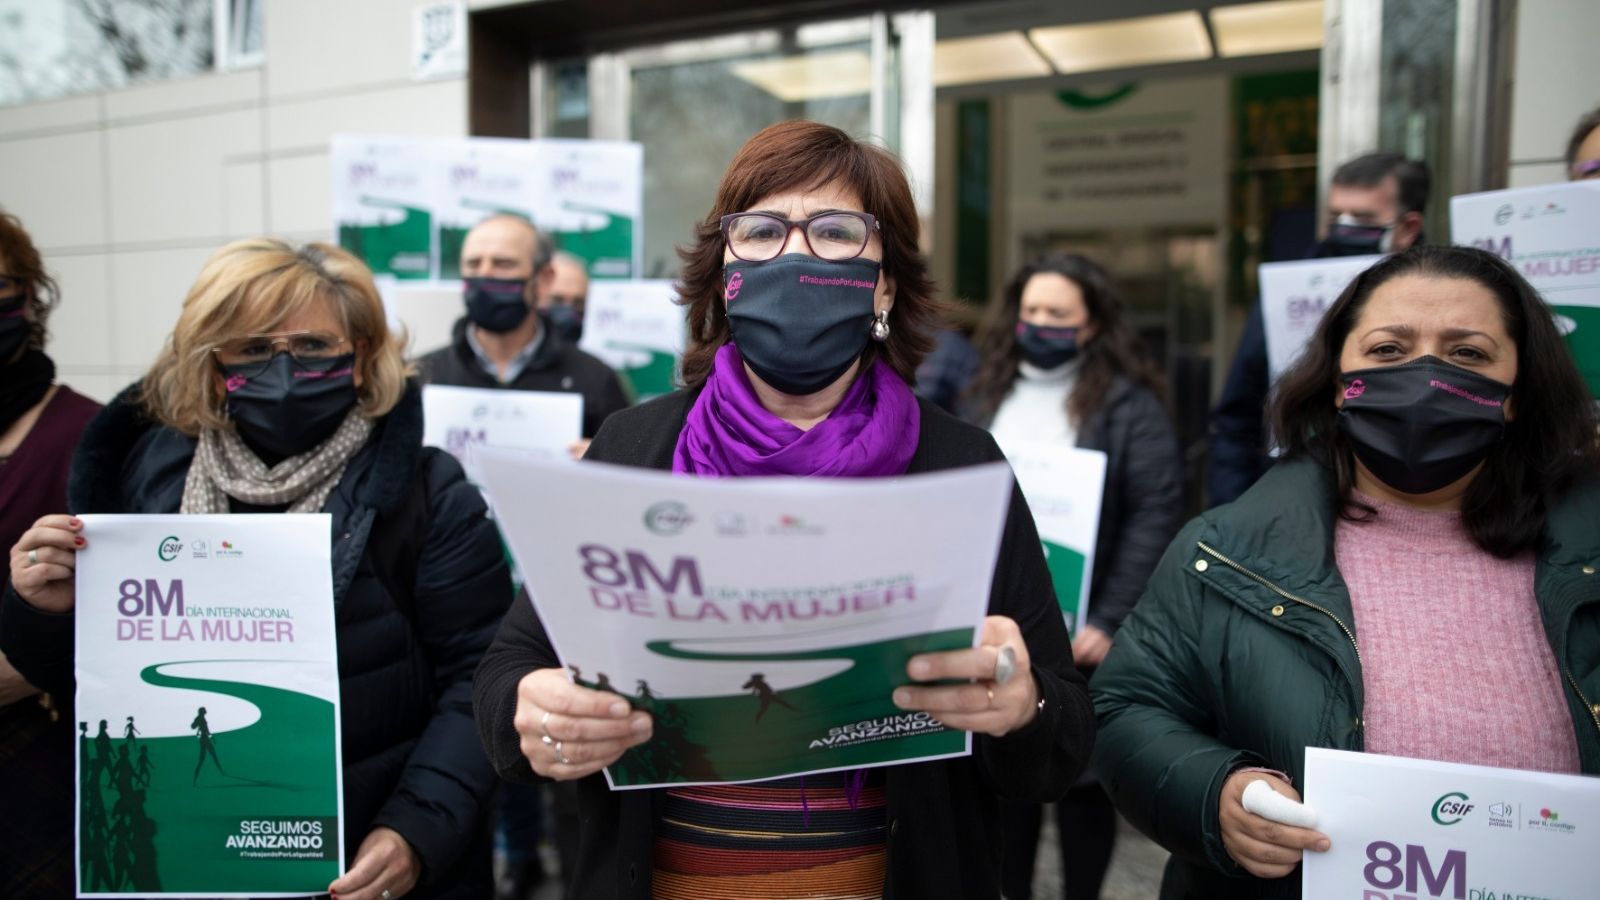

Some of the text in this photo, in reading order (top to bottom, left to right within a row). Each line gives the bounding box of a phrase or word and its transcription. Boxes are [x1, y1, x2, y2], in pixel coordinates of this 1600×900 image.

[578, 543, 704, 597] 8M
[117, 578, 185, 617] 8M
[589, 584, 915, 624] DE LA MUJER
[186, 604, 294, 620] DÍA INTERNACIONAL
[117, 619, 295, 643] DE LA MUJER
[808, 718, 943, 749] AVANZANDO
[828, 711, 931, 736] SEGUIMO
[240, 820, 323, 835] SEGUIMOS
[225, 835, 323, 849] AVANZANDO
[1363, 840, 1467, 900] 8M
